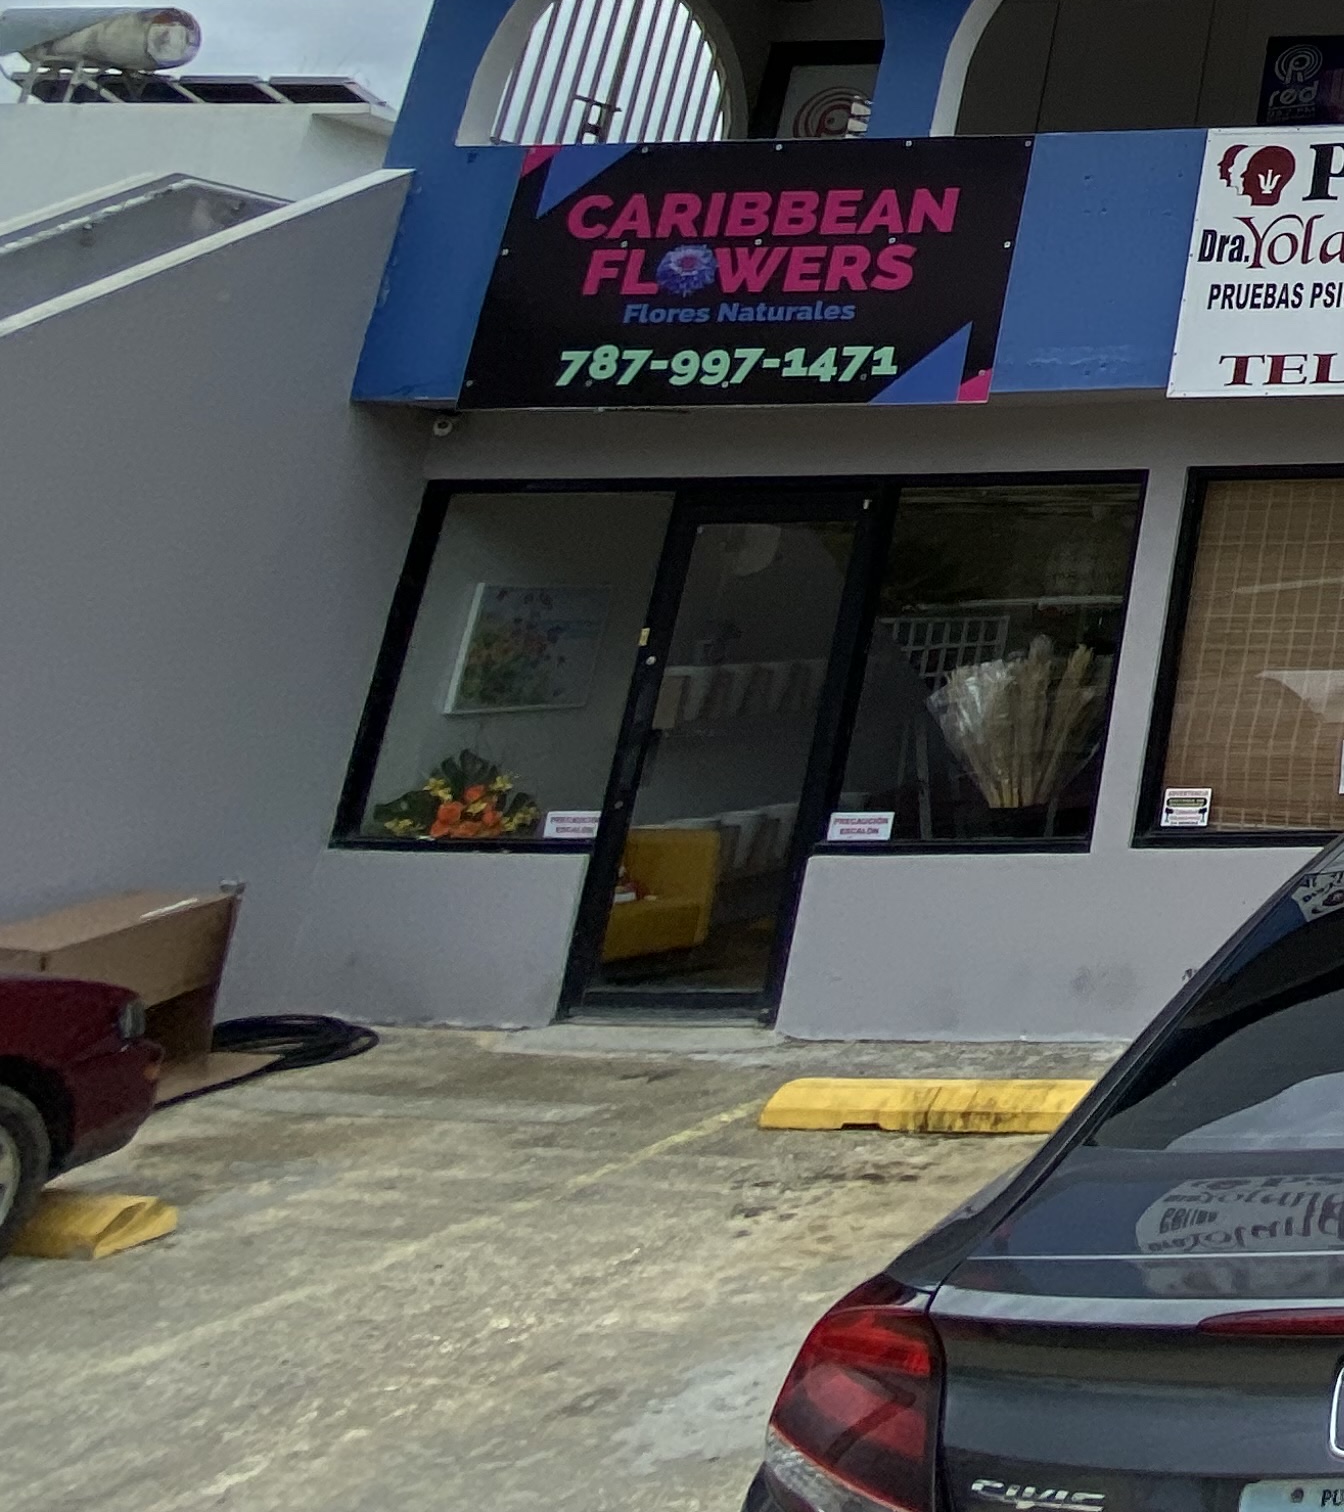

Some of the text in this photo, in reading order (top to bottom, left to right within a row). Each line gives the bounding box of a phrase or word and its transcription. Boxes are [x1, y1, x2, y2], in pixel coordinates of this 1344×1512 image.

[566, 187, 960, 240] CARIBBEAN
[1198, 227, 1250, 264] Dra.
[622, 300, 856, 324] Flores Naturales
[1207, 282, 1304, 310] PRUEBAS
[555, 344, 898, 387] 787-997-1471
